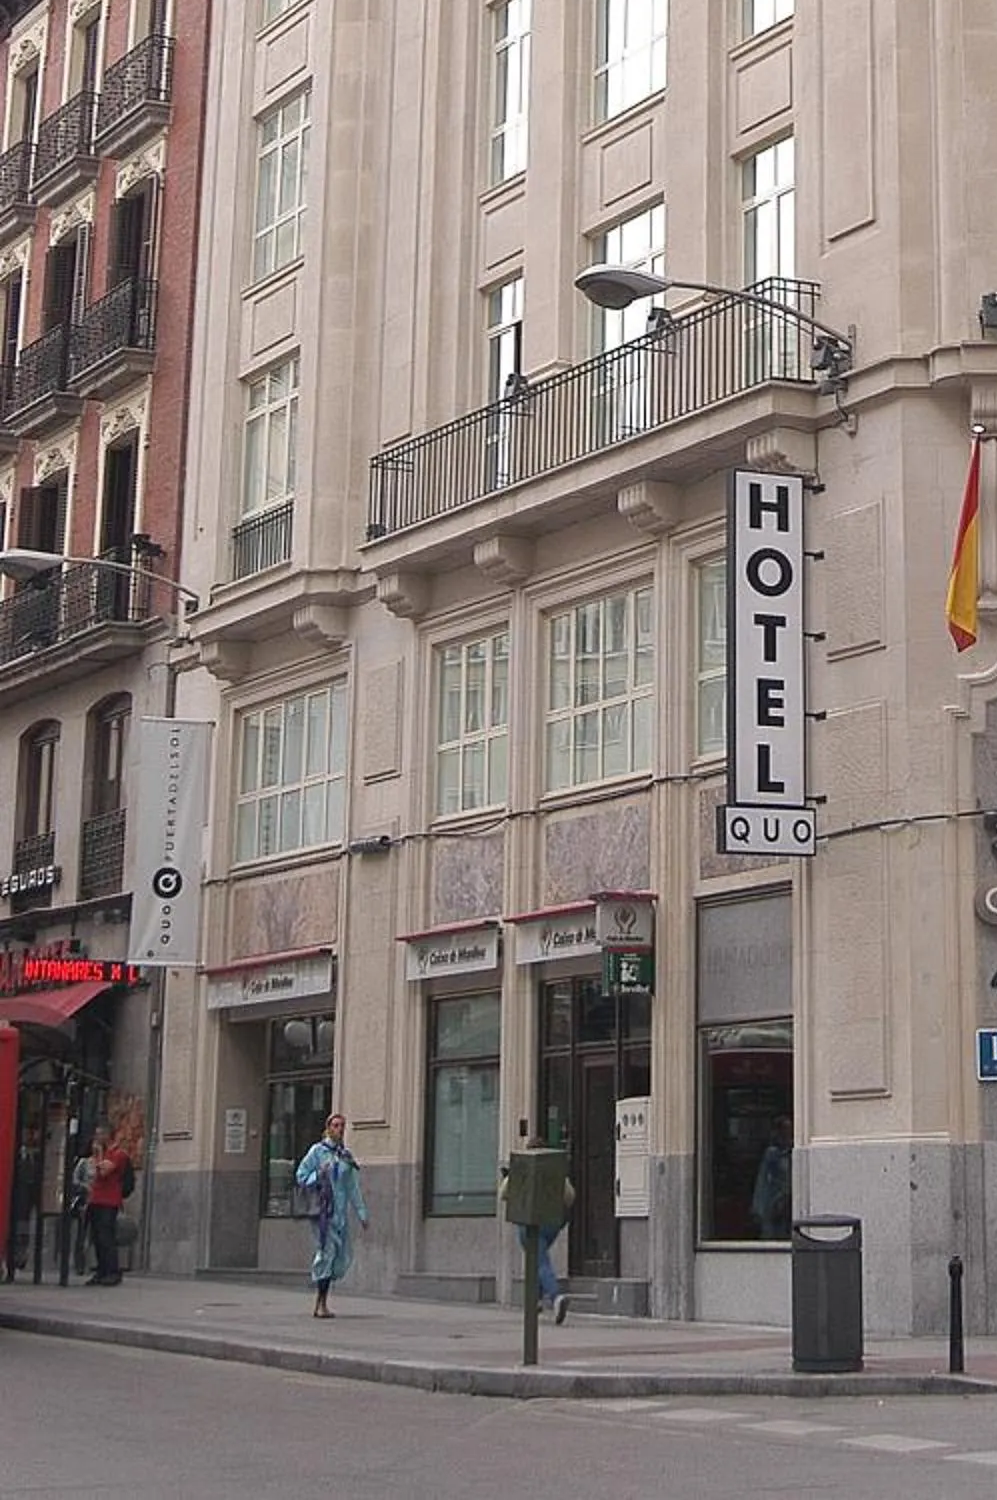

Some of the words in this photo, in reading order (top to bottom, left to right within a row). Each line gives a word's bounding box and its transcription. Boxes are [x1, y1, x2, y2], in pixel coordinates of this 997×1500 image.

[746, 482, 793, 793] HOTEL
[730, 815, 812, 844] QUO
[161, 905, 172, 945] QUO
